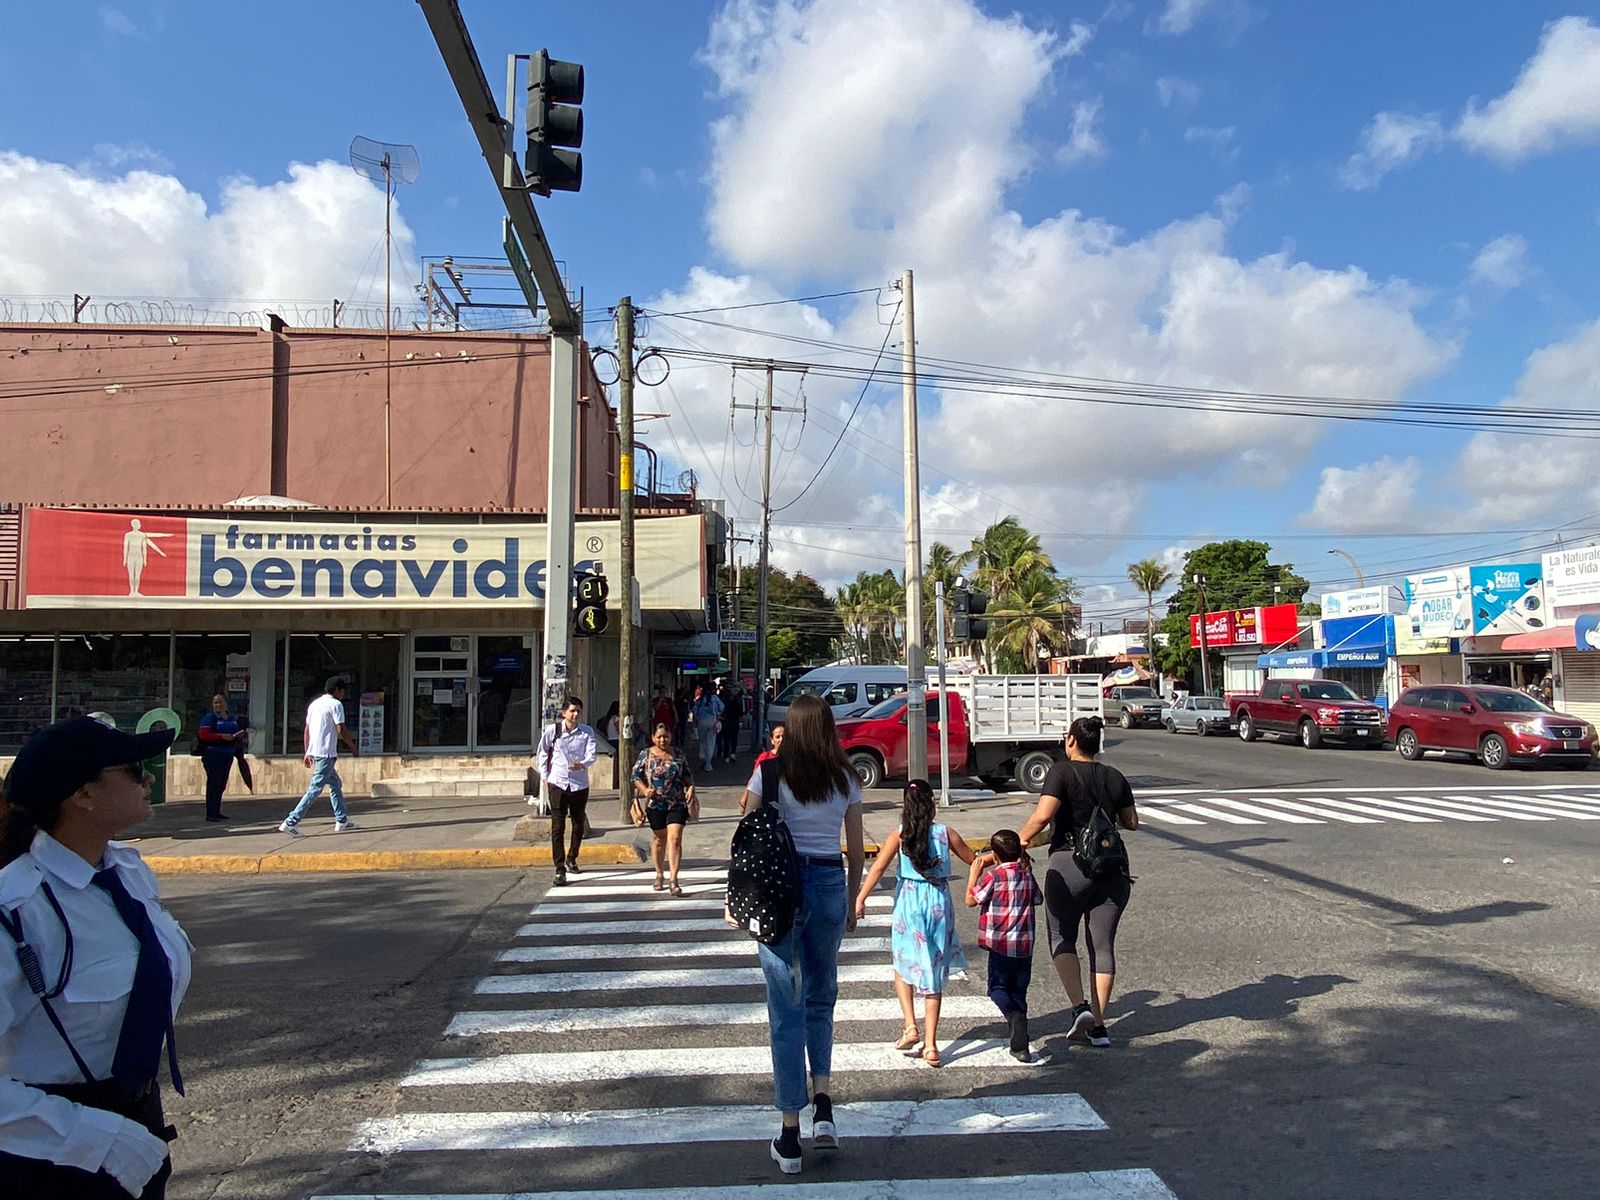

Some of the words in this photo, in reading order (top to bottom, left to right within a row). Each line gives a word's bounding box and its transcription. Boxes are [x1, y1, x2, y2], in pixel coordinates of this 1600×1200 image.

[226, 525, 417, 551] farmacias
[1549, 555, 1561, 566] La
[1565, 566, 1576, 576] es
[1578, 562, 1598, 574] Vida
[583, 582, 602, 599] 21
